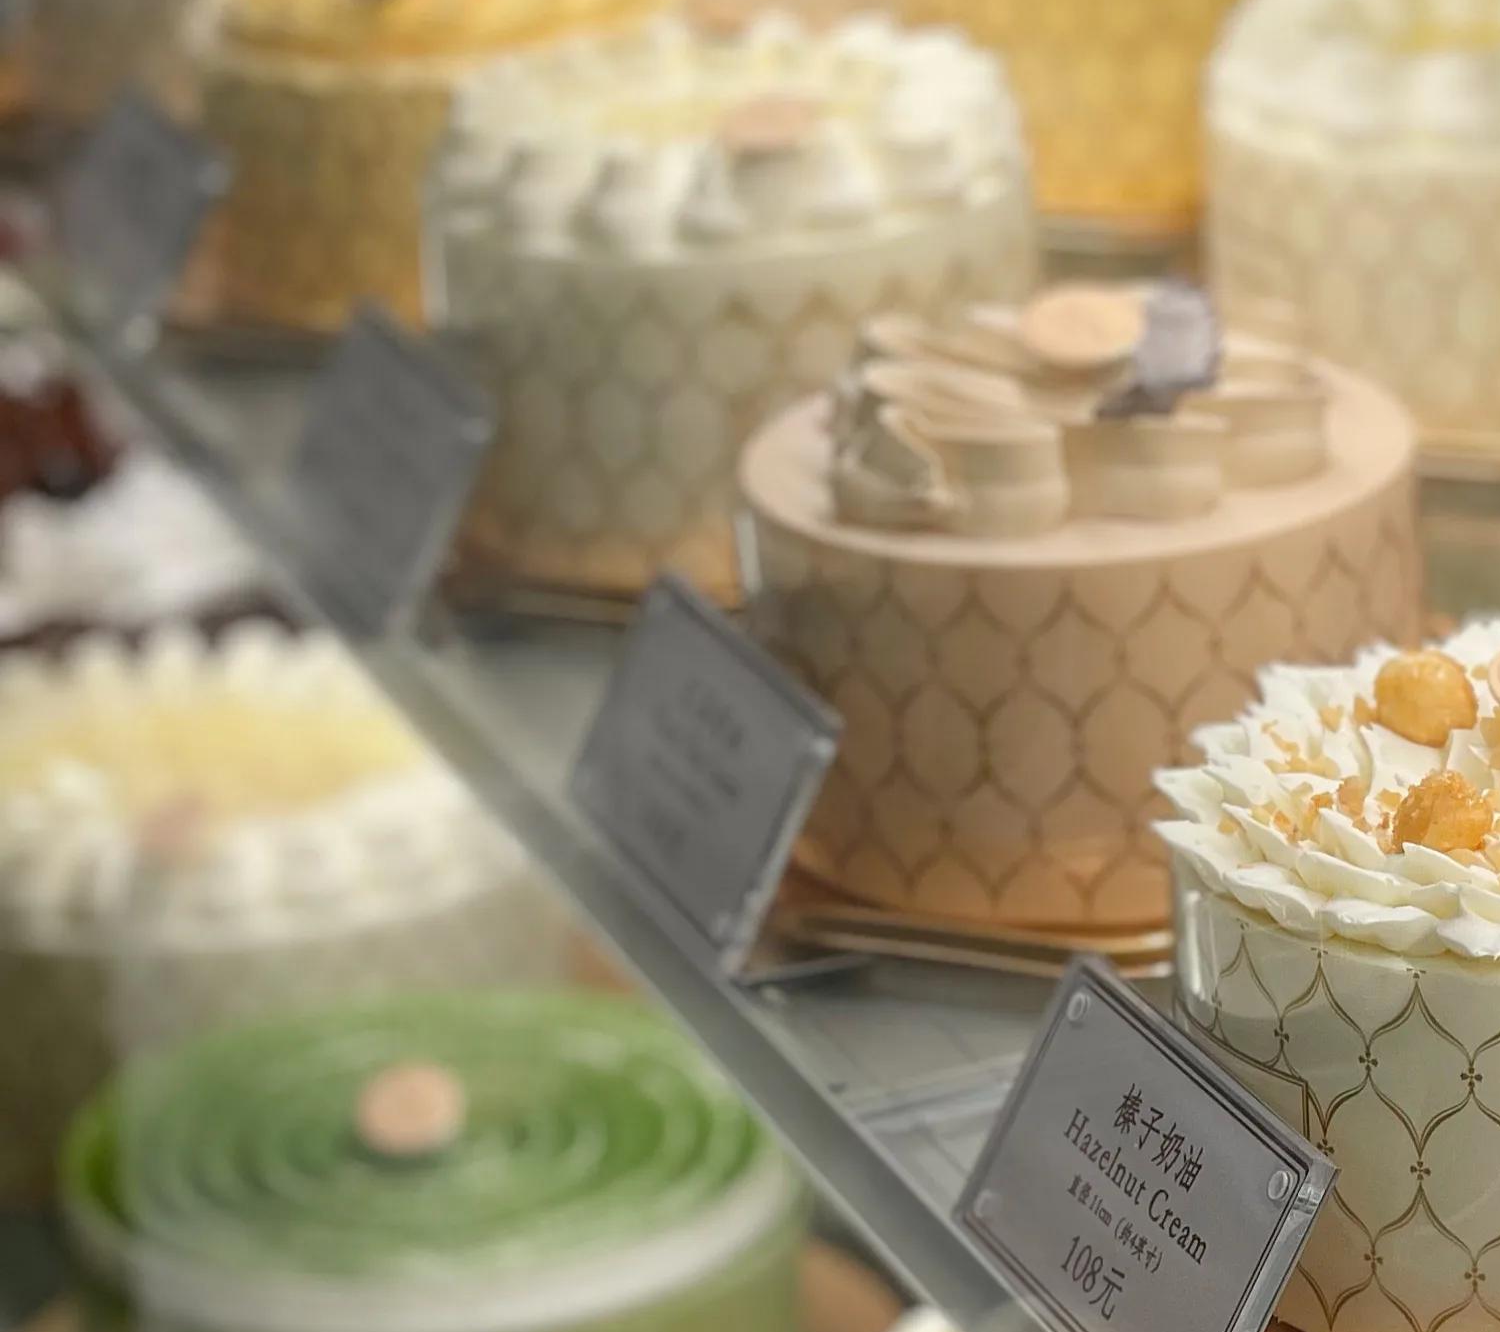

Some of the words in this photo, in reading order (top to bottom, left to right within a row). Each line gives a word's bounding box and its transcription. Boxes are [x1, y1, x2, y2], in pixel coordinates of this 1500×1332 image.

[1063, 1107, 1147, 1207] Hazelnut
[1148, 1180, 1208, 1265] Cream
[1113, 1083, 1204, 1194] 榛子奶油
[1061, 1234, 1128, 1322] 108元
